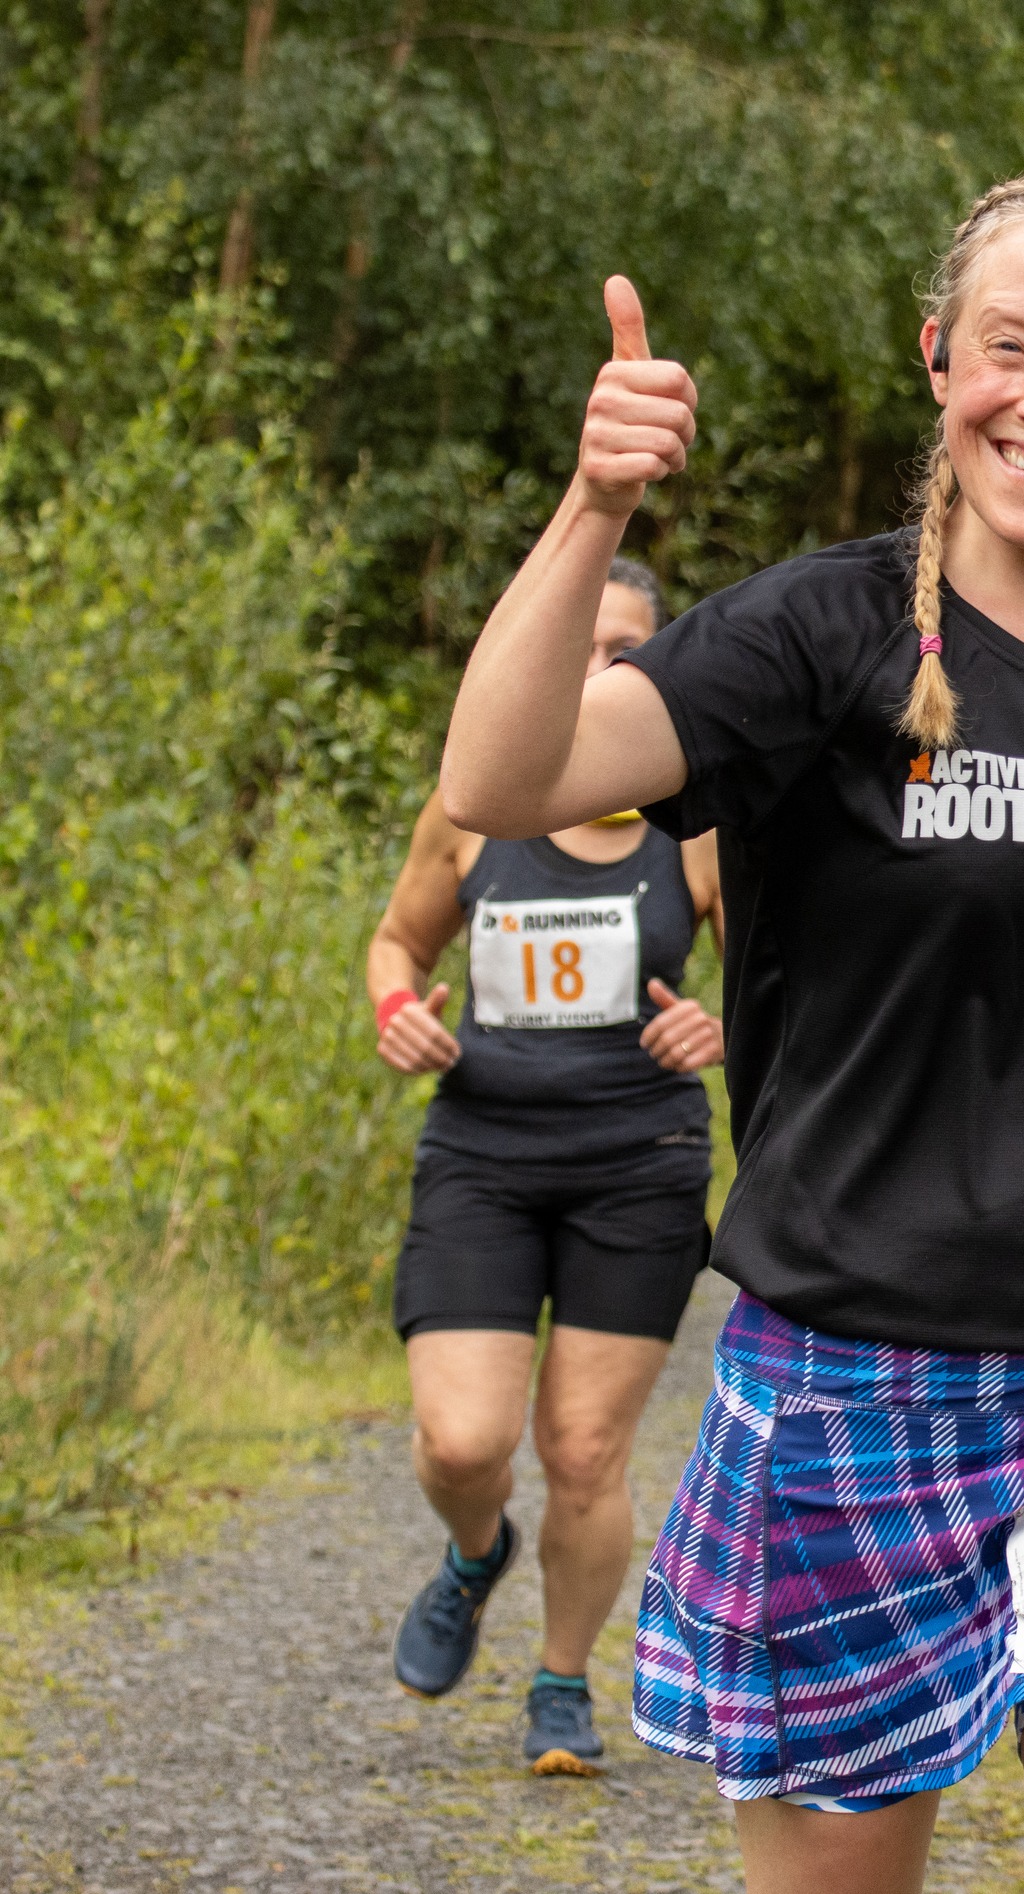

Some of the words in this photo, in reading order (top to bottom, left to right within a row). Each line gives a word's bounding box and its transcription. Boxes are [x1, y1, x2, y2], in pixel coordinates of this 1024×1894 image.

[523, 910, 622, 931] RUNNING
[522, 940, 585, 1004] 18
[556, 1010, 606, 1026] EVENTS
